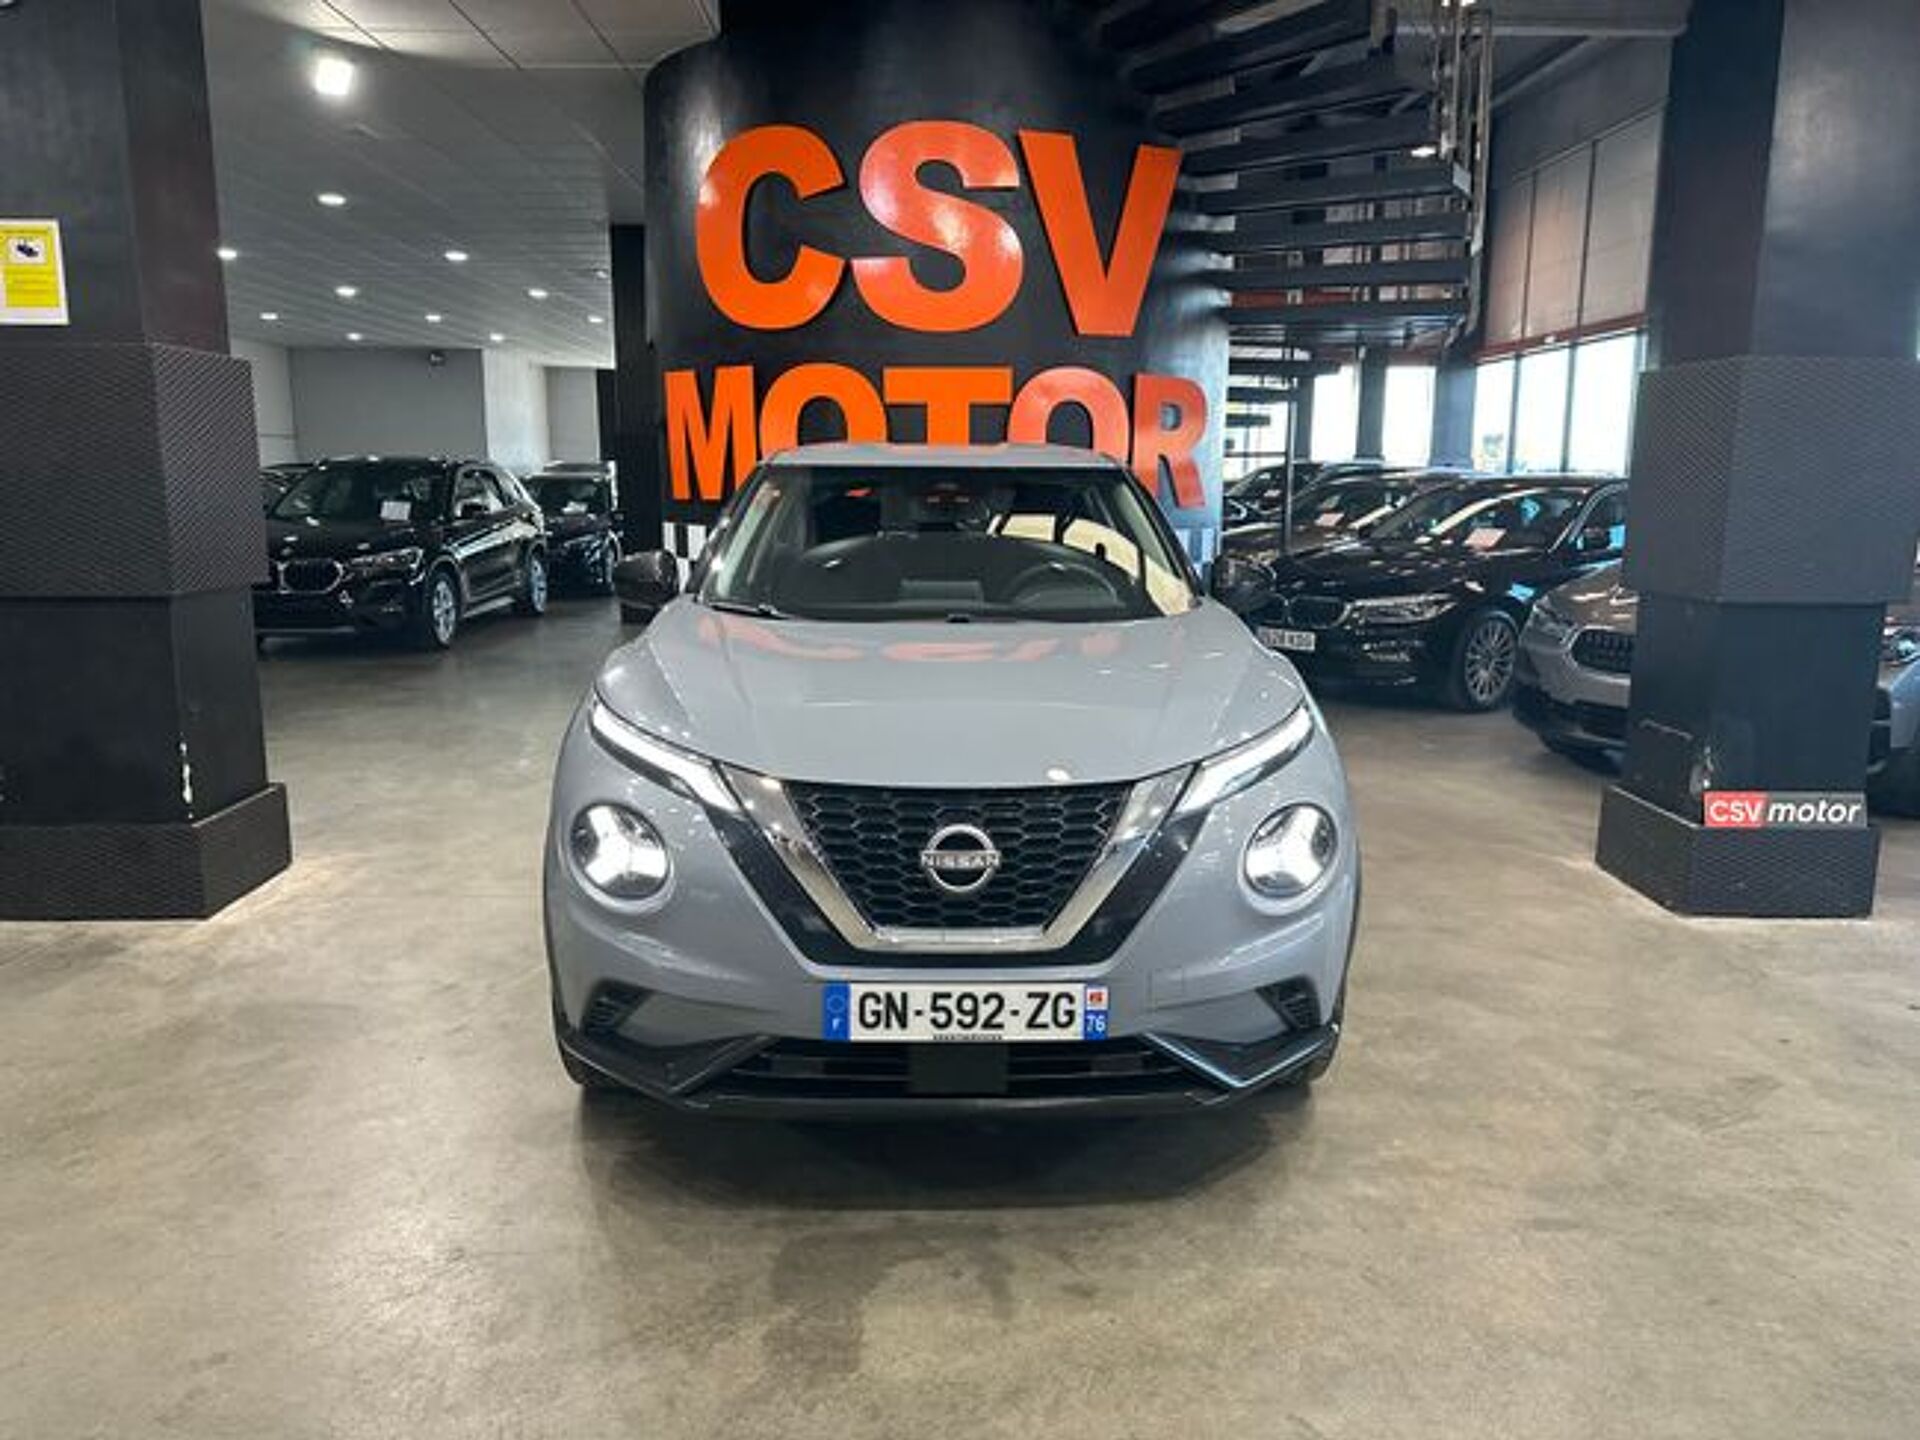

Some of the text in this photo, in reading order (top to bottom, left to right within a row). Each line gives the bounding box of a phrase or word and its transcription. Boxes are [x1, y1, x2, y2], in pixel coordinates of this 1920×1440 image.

[696, 120, 1183, 337] CSV
[664, 363, 1208, 507] MOTOR
[1709, 800, 1861, 822] CSV motor
[922, 852, 999, 868] NISSAN
[858, 992, 1075, 1029] GN-592-ZG
[1087, 1014, 1105, 1031] 76
